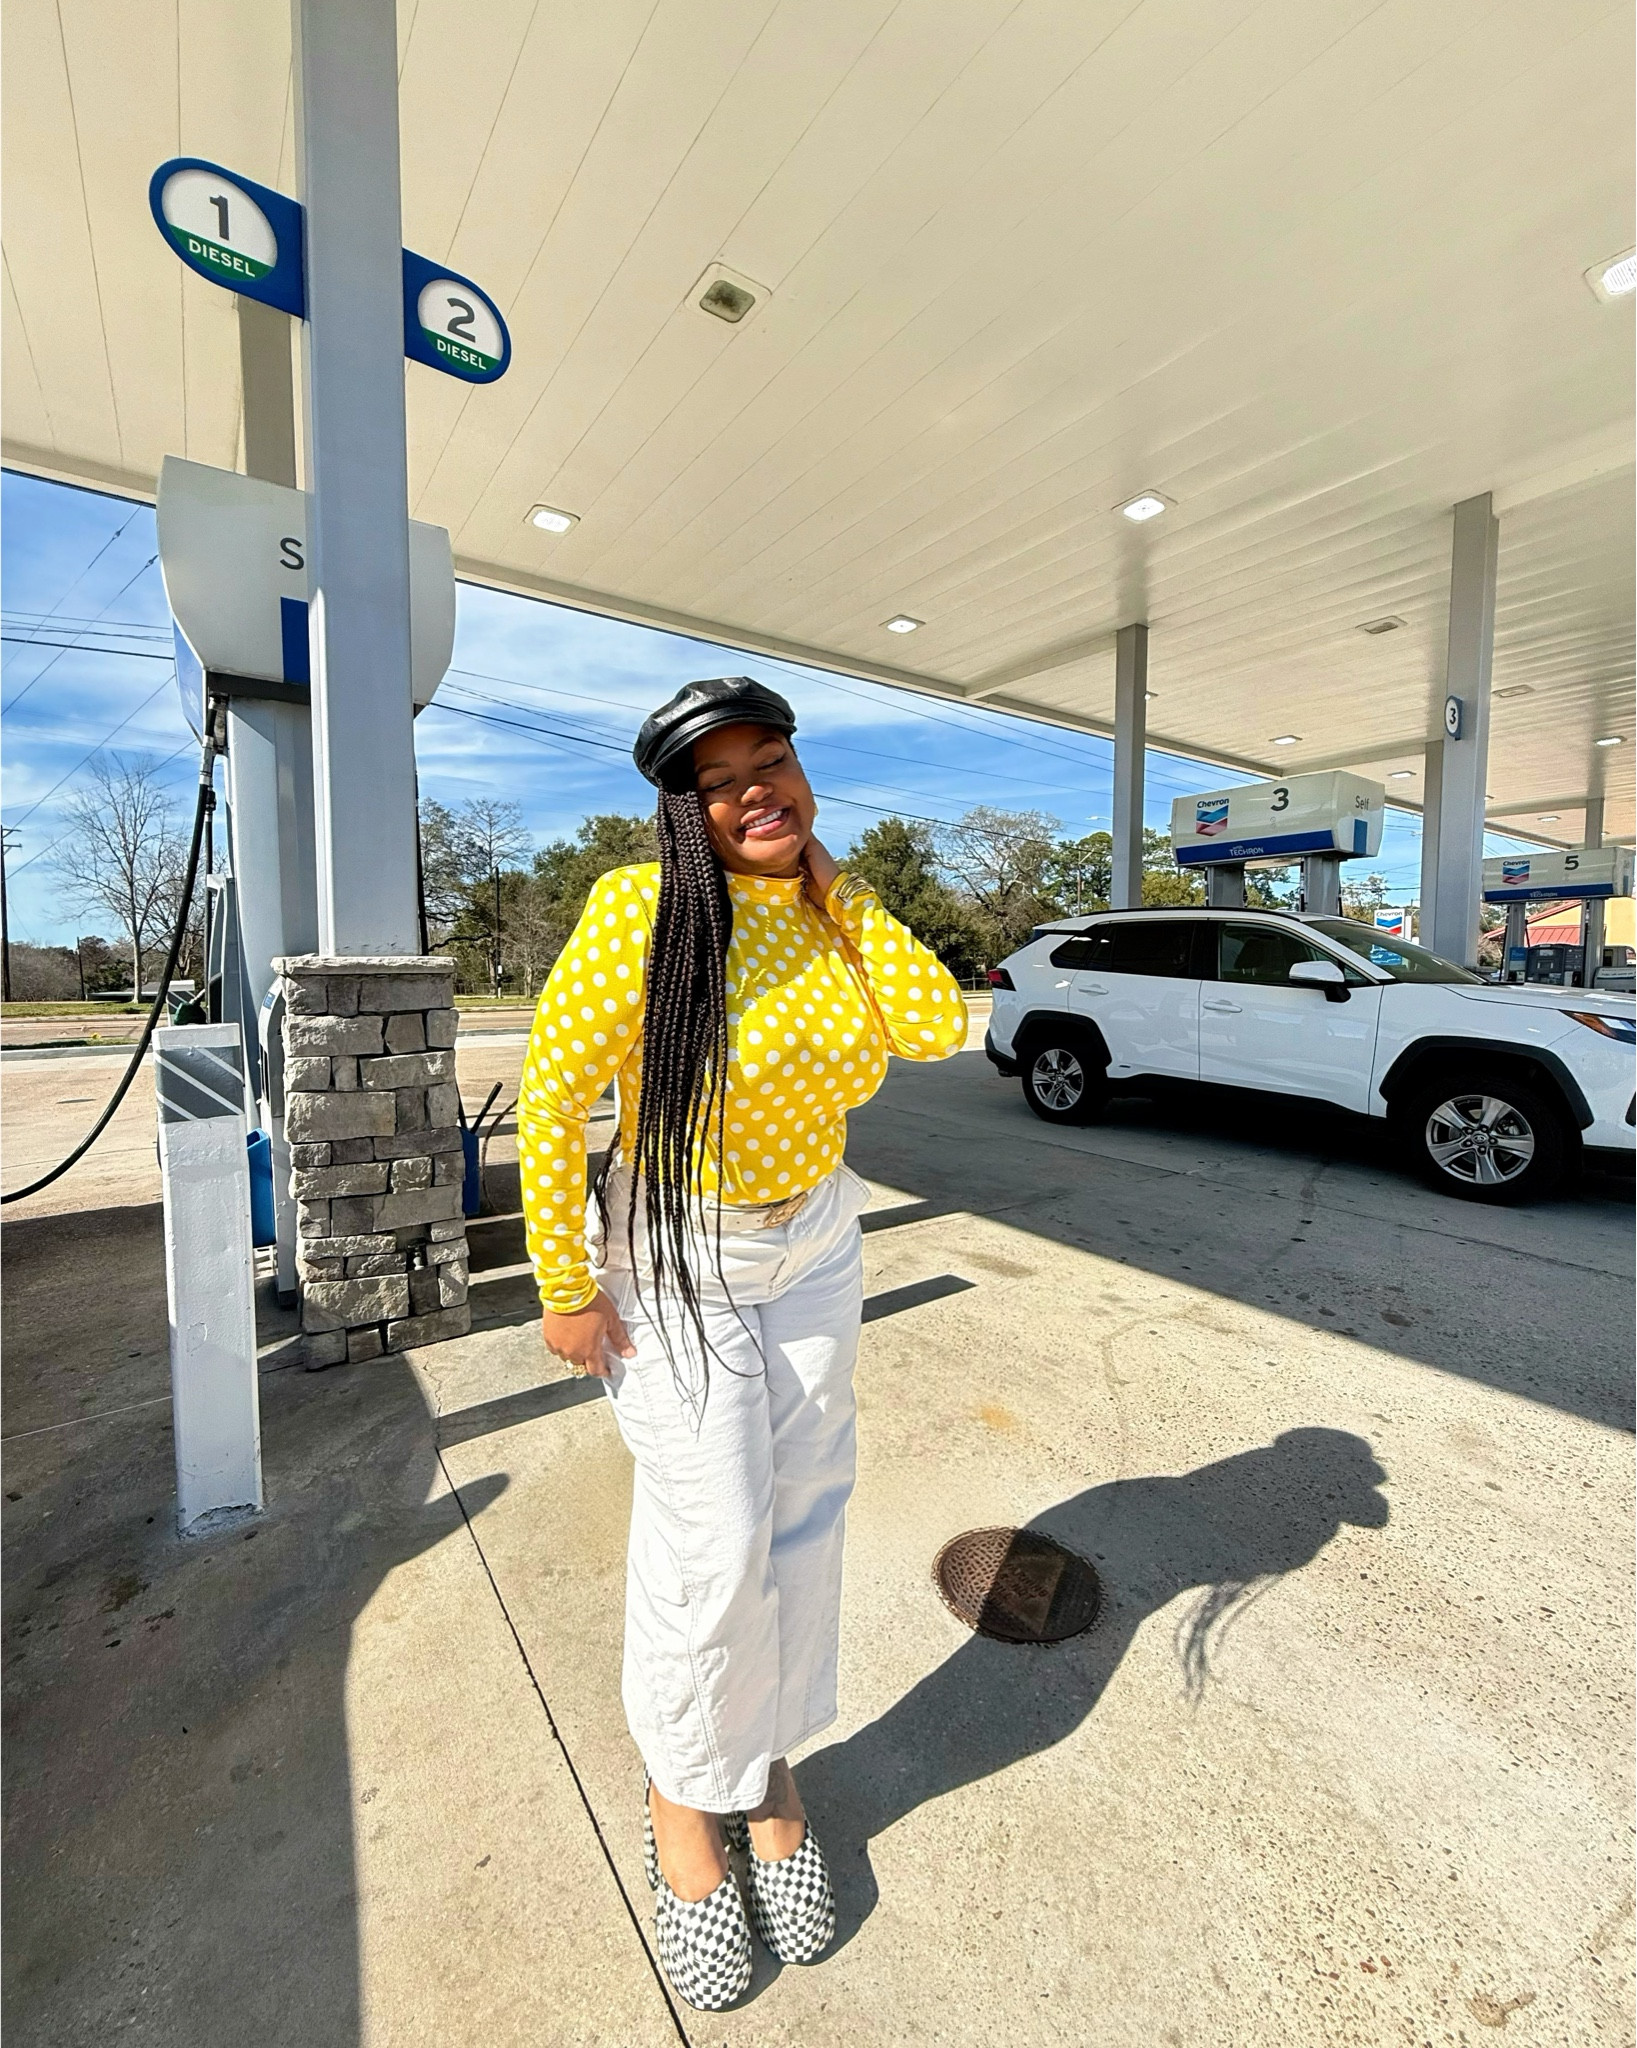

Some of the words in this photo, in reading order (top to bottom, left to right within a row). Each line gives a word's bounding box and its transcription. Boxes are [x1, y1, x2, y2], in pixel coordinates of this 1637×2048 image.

[209, 195, 230, 241] 1
[188, 238, 256, 278] DIESEL
[446, 297, 476, 343] 2
[436, 338, 487, 370] DIESEL
[1449, 708, 1456, 725] 3
[1197, 798, 1230, 809] Chevron
[1270, 787, 1290, 812] 3
[1355, 795, 1370, 811] Self
[1564, 855, 1580, 870] 5
